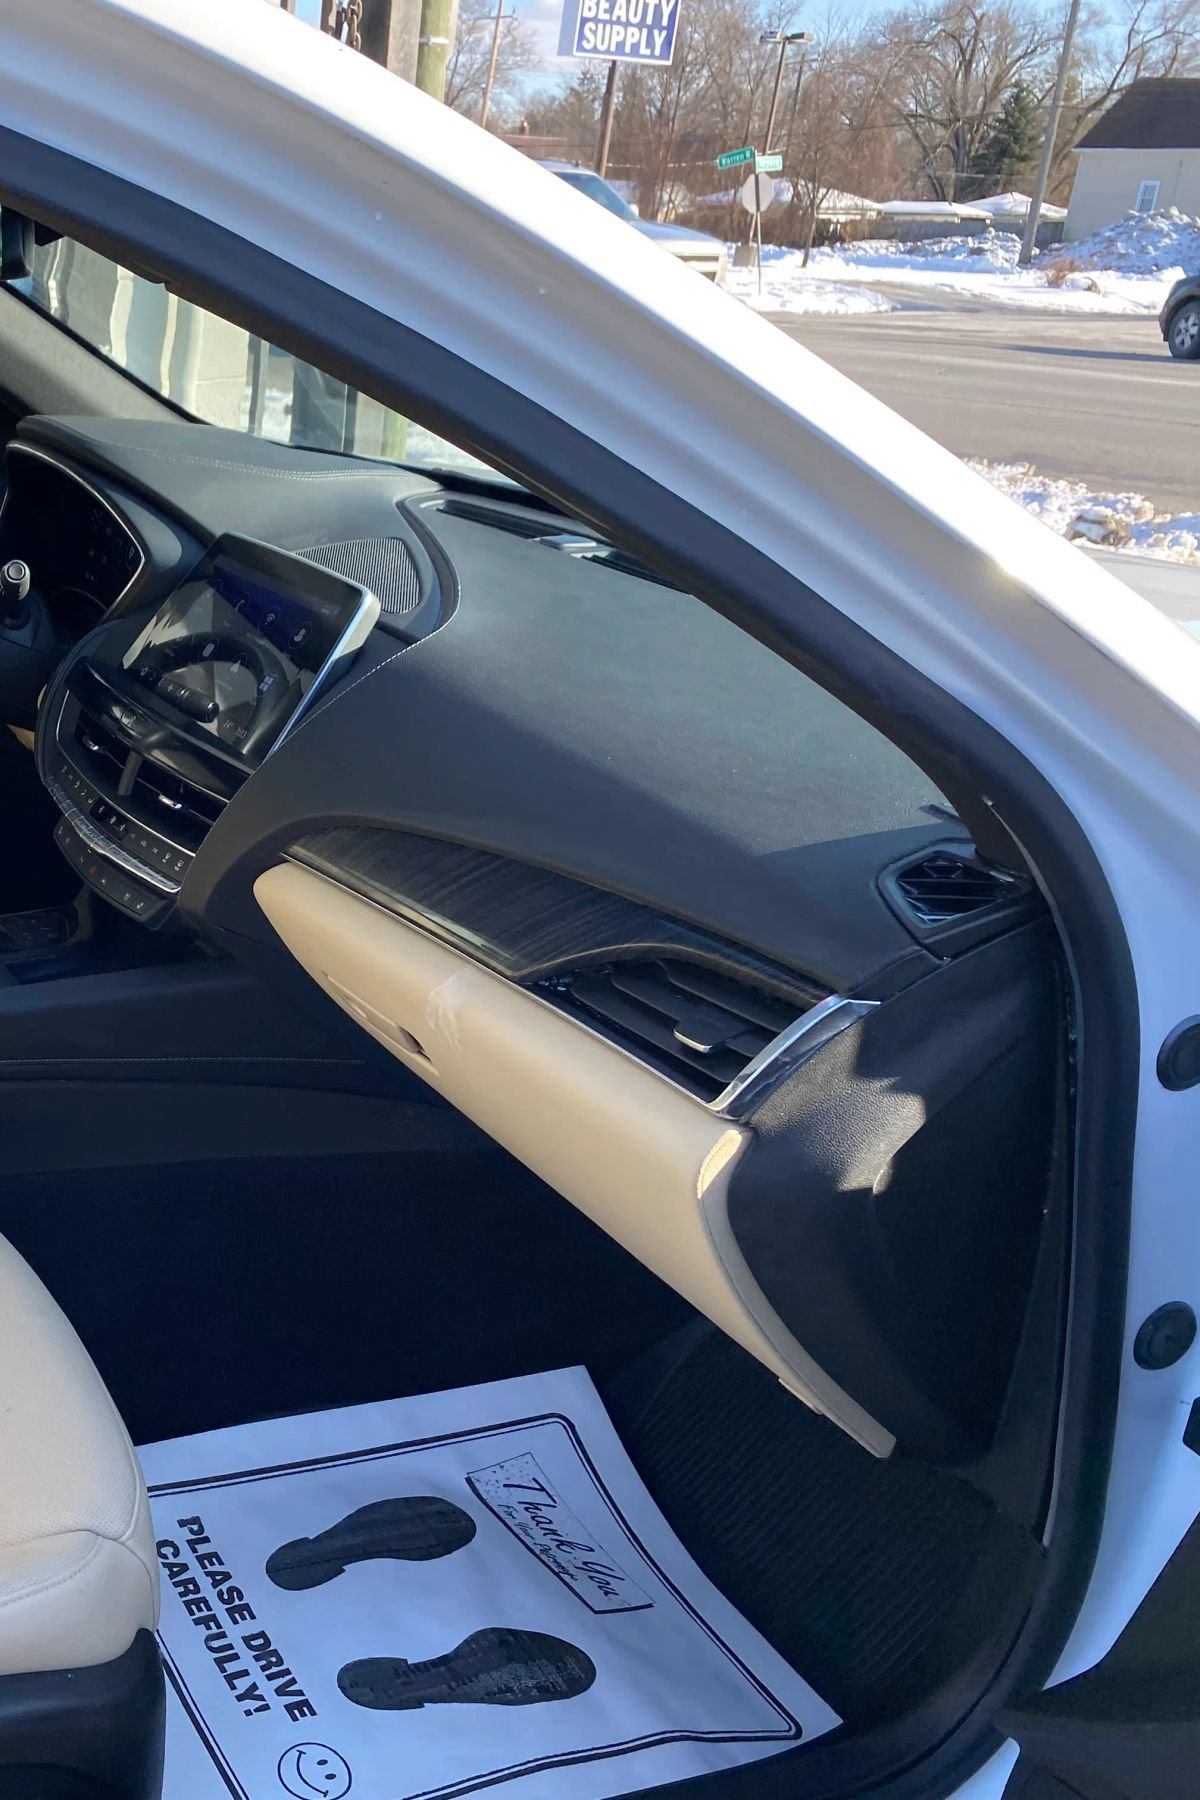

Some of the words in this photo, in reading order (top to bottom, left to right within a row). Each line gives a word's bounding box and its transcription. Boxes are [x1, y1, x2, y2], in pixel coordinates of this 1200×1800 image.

[581, 21, 667, 56] SUPPLY
[582, 0, 675, 27] BEAUTY
[502, 1477, 595, 1554] Thank
[573, 1560, 625, 1597] You
[155, 1538, 271, 1717] CAREFULLY!
[176, 1515, 257, 1625] PLEASE
[240, 1630, 318, 1723] DRIVE
